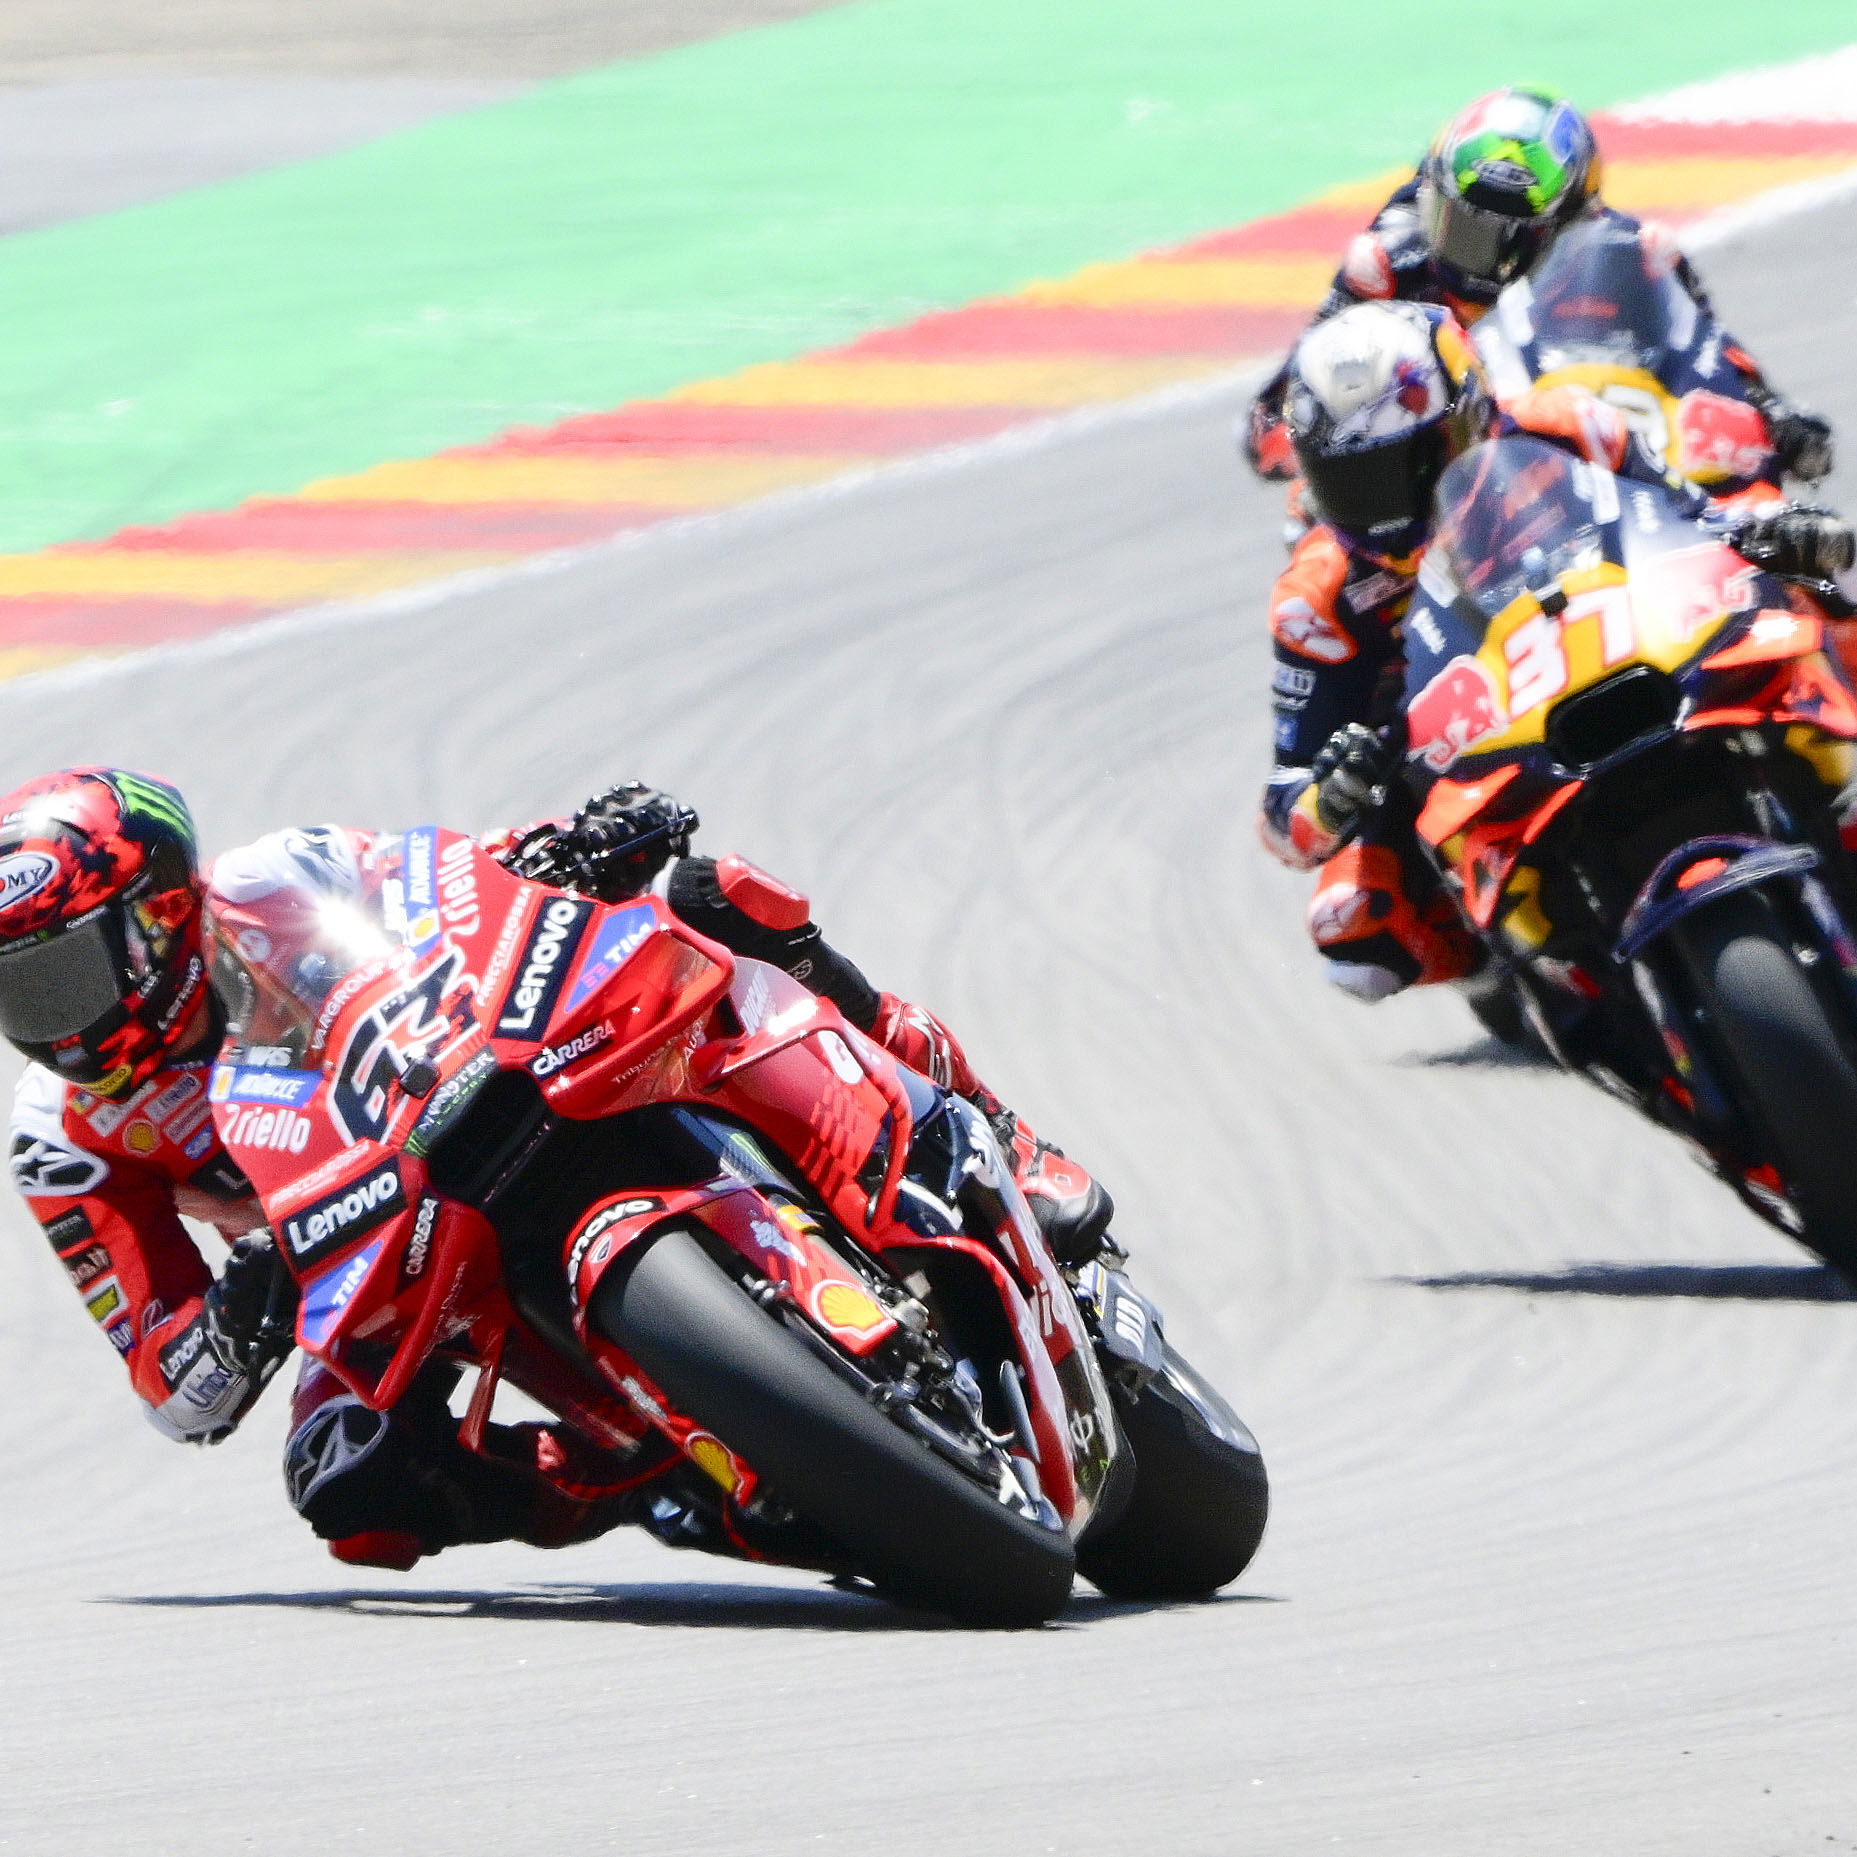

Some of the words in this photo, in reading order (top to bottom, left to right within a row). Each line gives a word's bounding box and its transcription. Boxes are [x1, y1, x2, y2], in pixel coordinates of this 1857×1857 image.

[1504, 584, 1637, 719] 37
[0, 866, 43, 890] MY
[499, 900, 577, 1030] Lenovo
[604, 922, 651, 962] TIM
[532, 1018, 616, 1076] CARRERA
[288, 1171, 398, 1255] Lenovo
[331, 1256, 369, 1306] TIM
